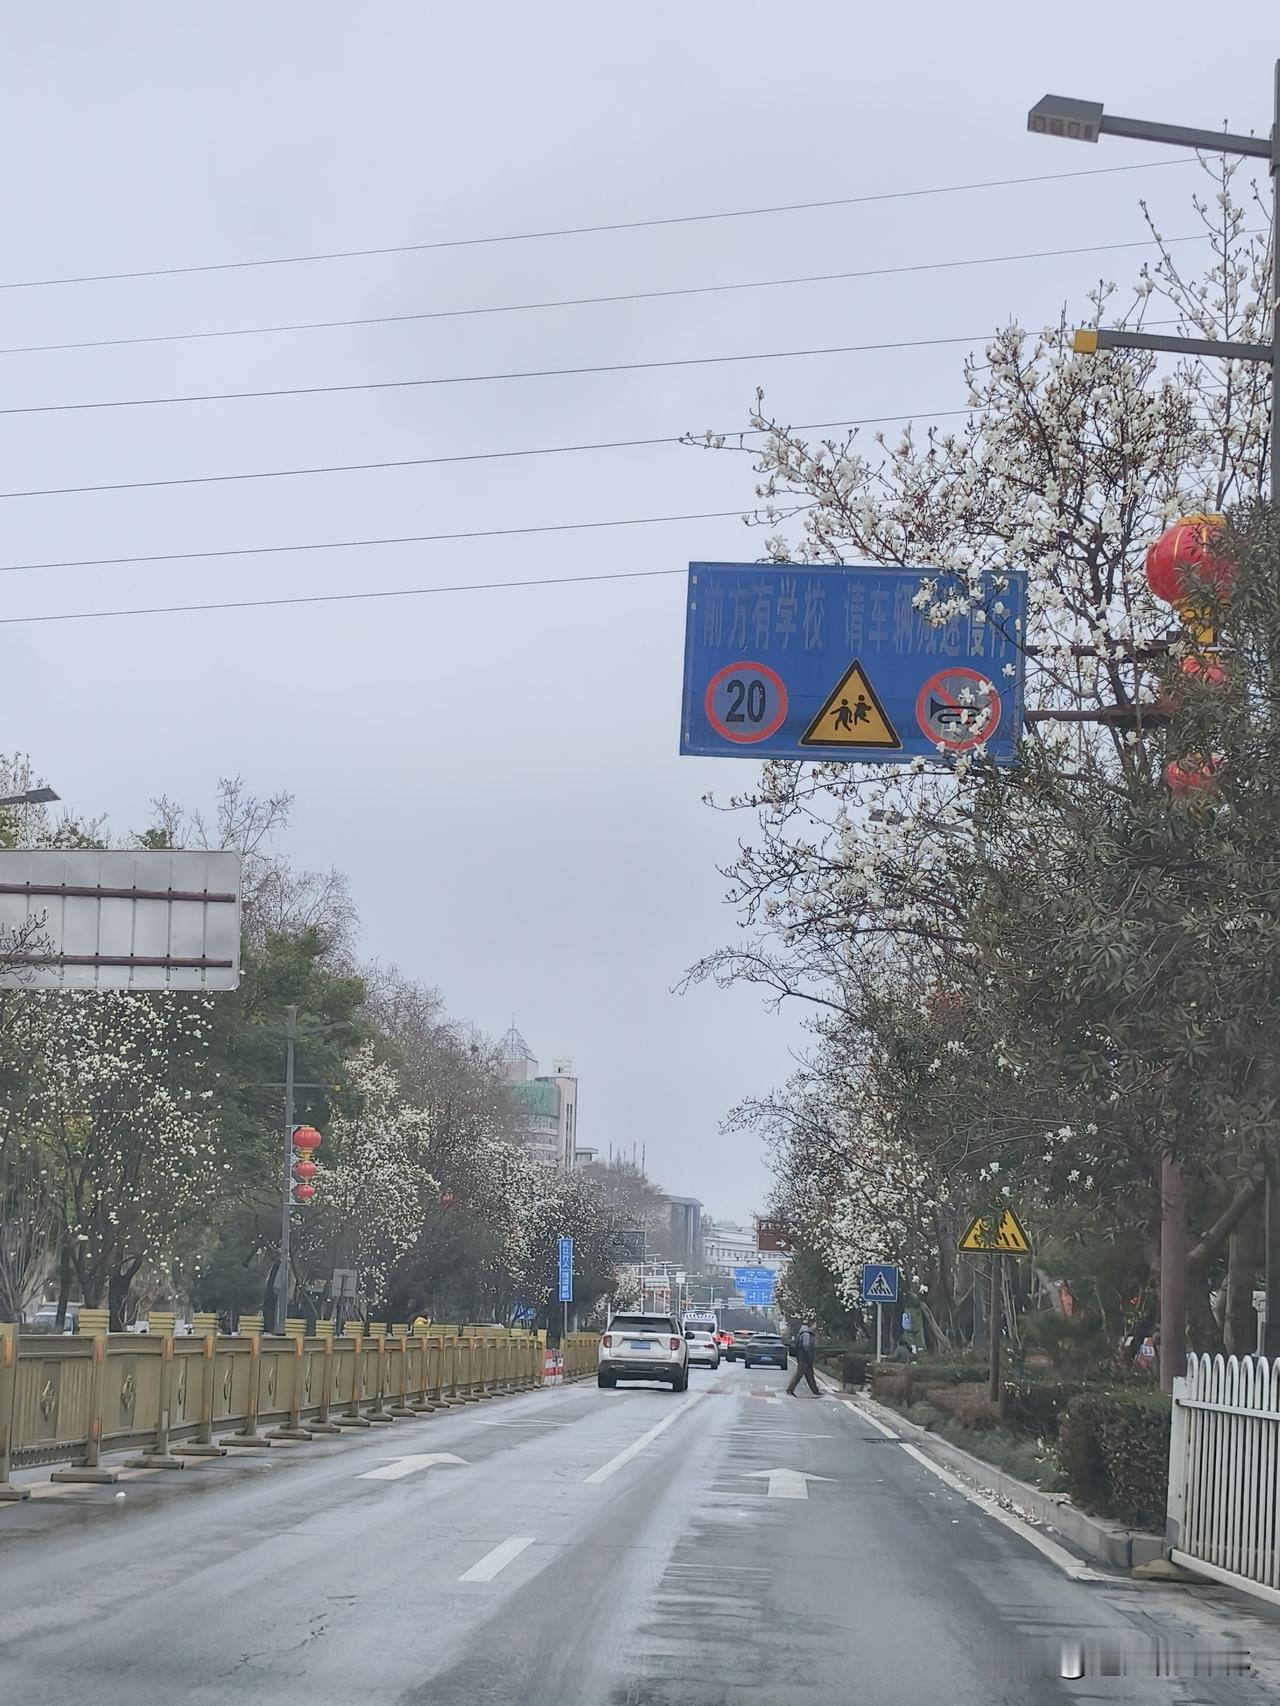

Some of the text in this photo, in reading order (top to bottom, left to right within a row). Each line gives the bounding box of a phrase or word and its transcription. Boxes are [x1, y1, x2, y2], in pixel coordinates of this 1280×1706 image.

[703, 575, 826, 651] 前方有学校
[725, 679, 766, 723] 20
